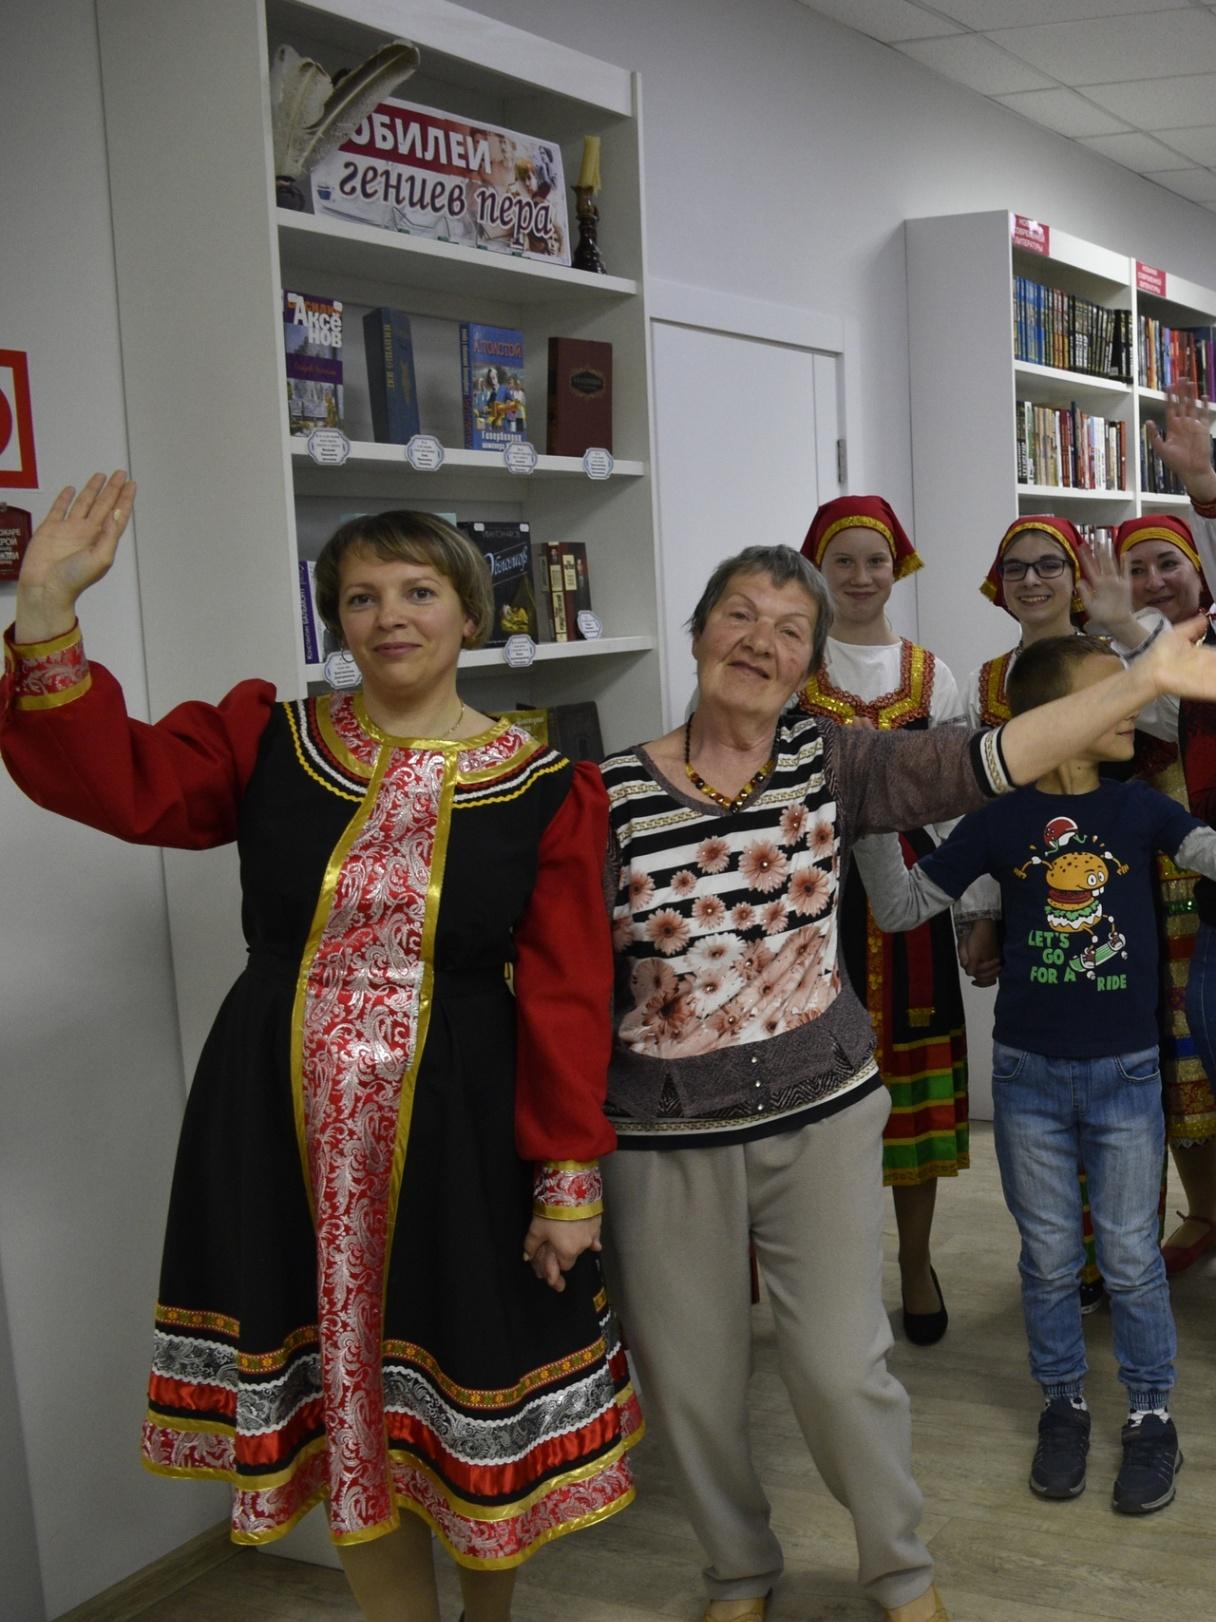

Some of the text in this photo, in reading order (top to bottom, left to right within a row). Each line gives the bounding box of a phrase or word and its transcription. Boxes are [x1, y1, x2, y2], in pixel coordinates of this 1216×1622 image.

[339, 161, 552, 249] гениев пера
[1028, 930, 1070, 948] LET'S
[1042, 948, 1065, 965] GO
[1030, 966, 1127, 992] FOR A RIDE
